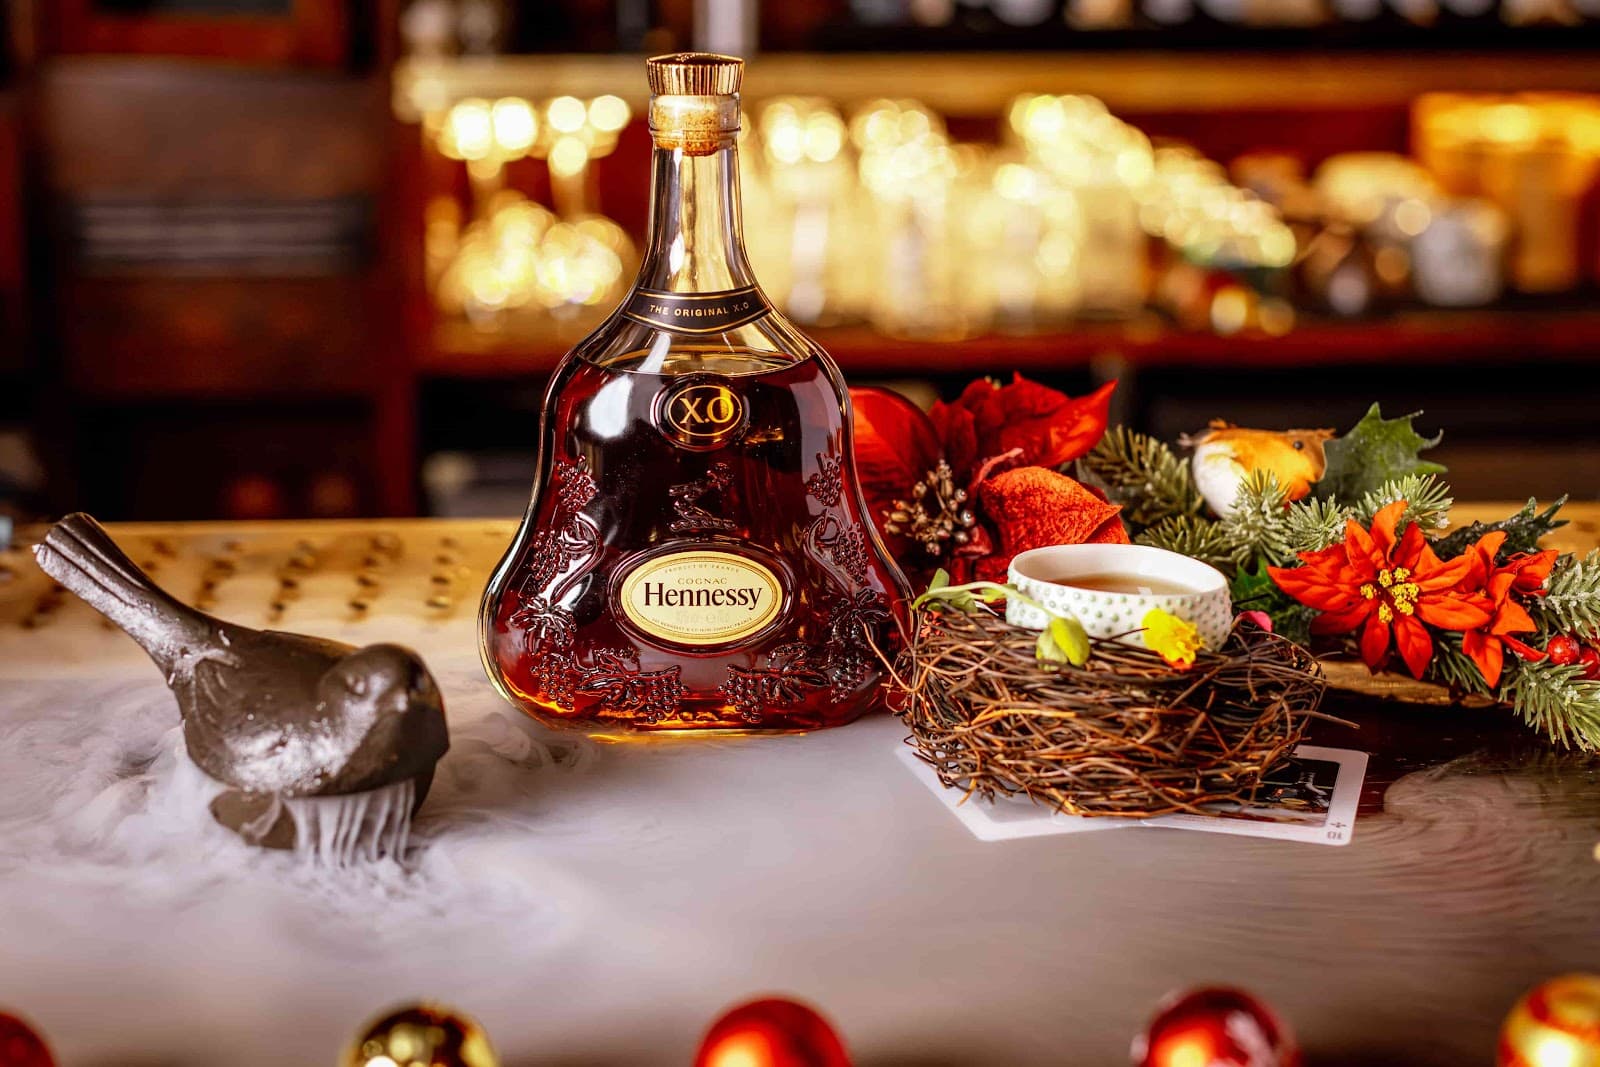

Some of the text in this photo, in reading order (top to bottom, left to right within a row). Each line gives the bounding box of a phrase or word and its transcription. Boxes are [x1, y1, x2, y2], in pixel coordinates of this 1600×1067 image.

[649, 304, 669, 315] THE
[674, 307, 729, 317] ORIGINAL
[679, 396, 734, 424] X.O
[677, 577, 728, 585] COGNAC
[644, 582, 763, 611] Hennessy
